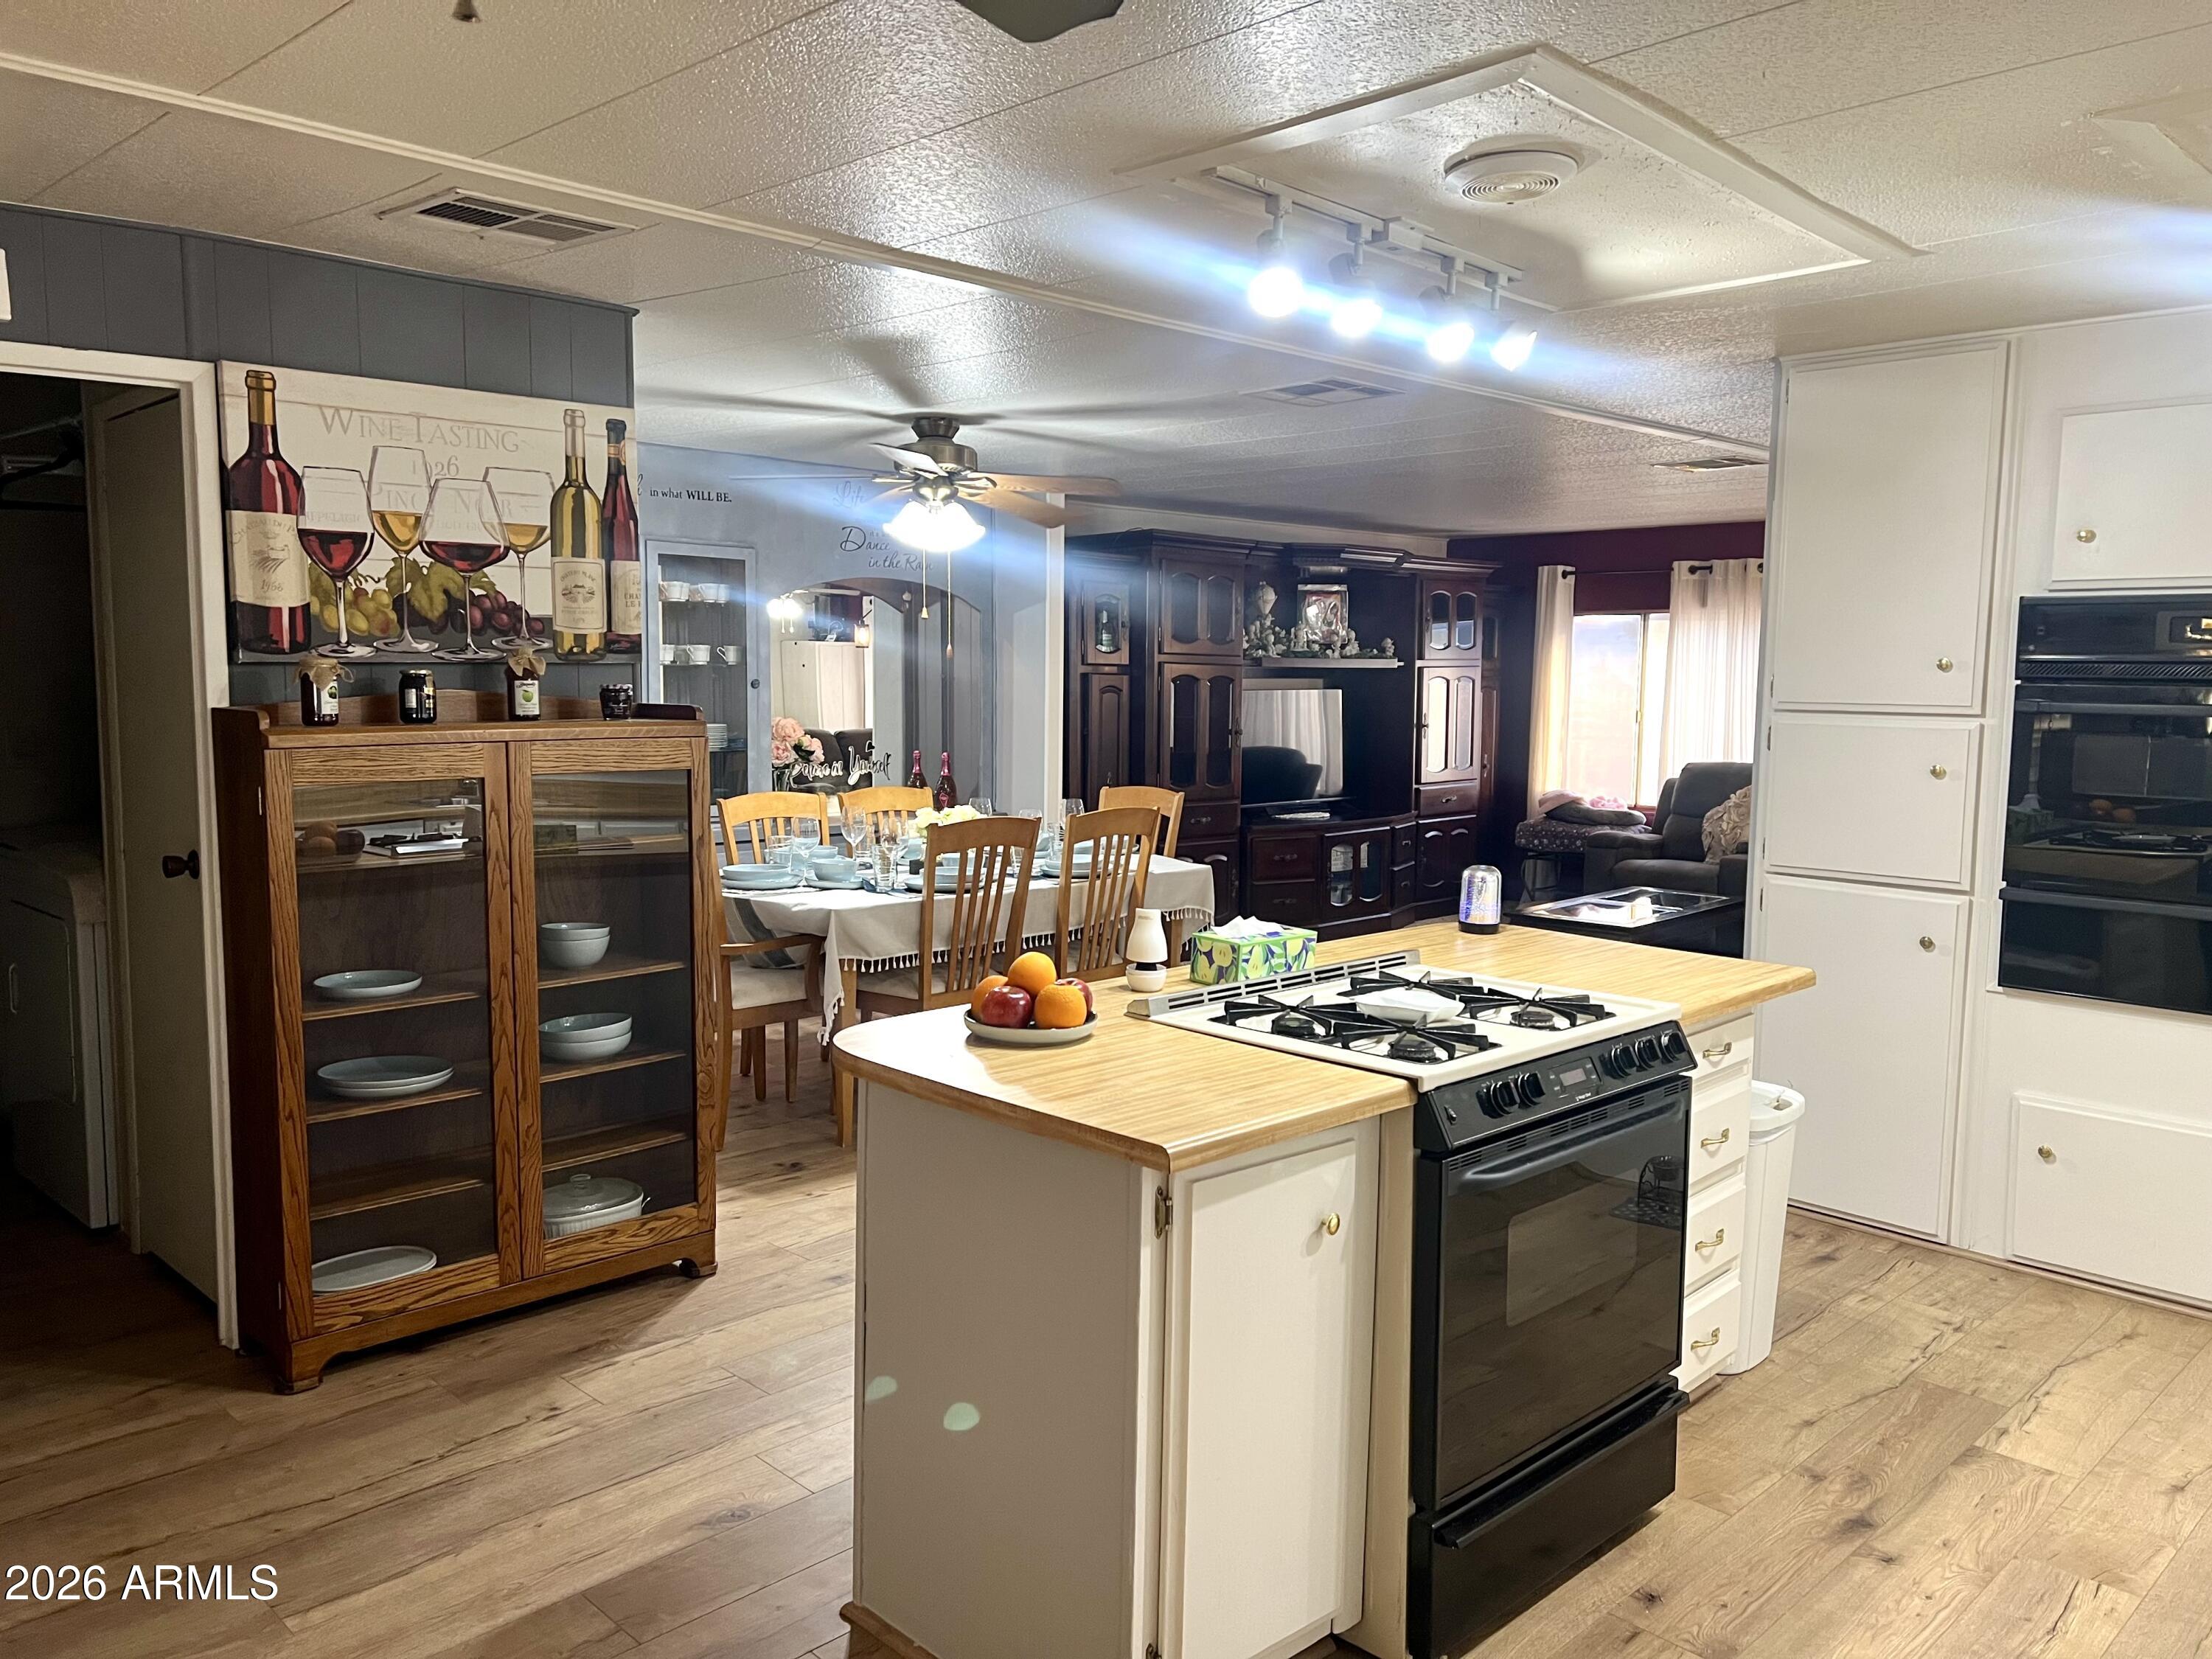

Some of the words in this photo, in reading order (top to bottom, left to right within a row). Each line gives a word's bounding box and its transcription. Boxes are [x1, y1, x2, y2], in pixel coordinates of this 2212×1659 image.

[650, 487, 658, 497] in
[661, 487, 683, 499] what
[686, 490, 714, 501] WILL
[840, 526, 890, 552] Dance
[869, 556, 880, 568] in
[883, 552, 902, 569] the
